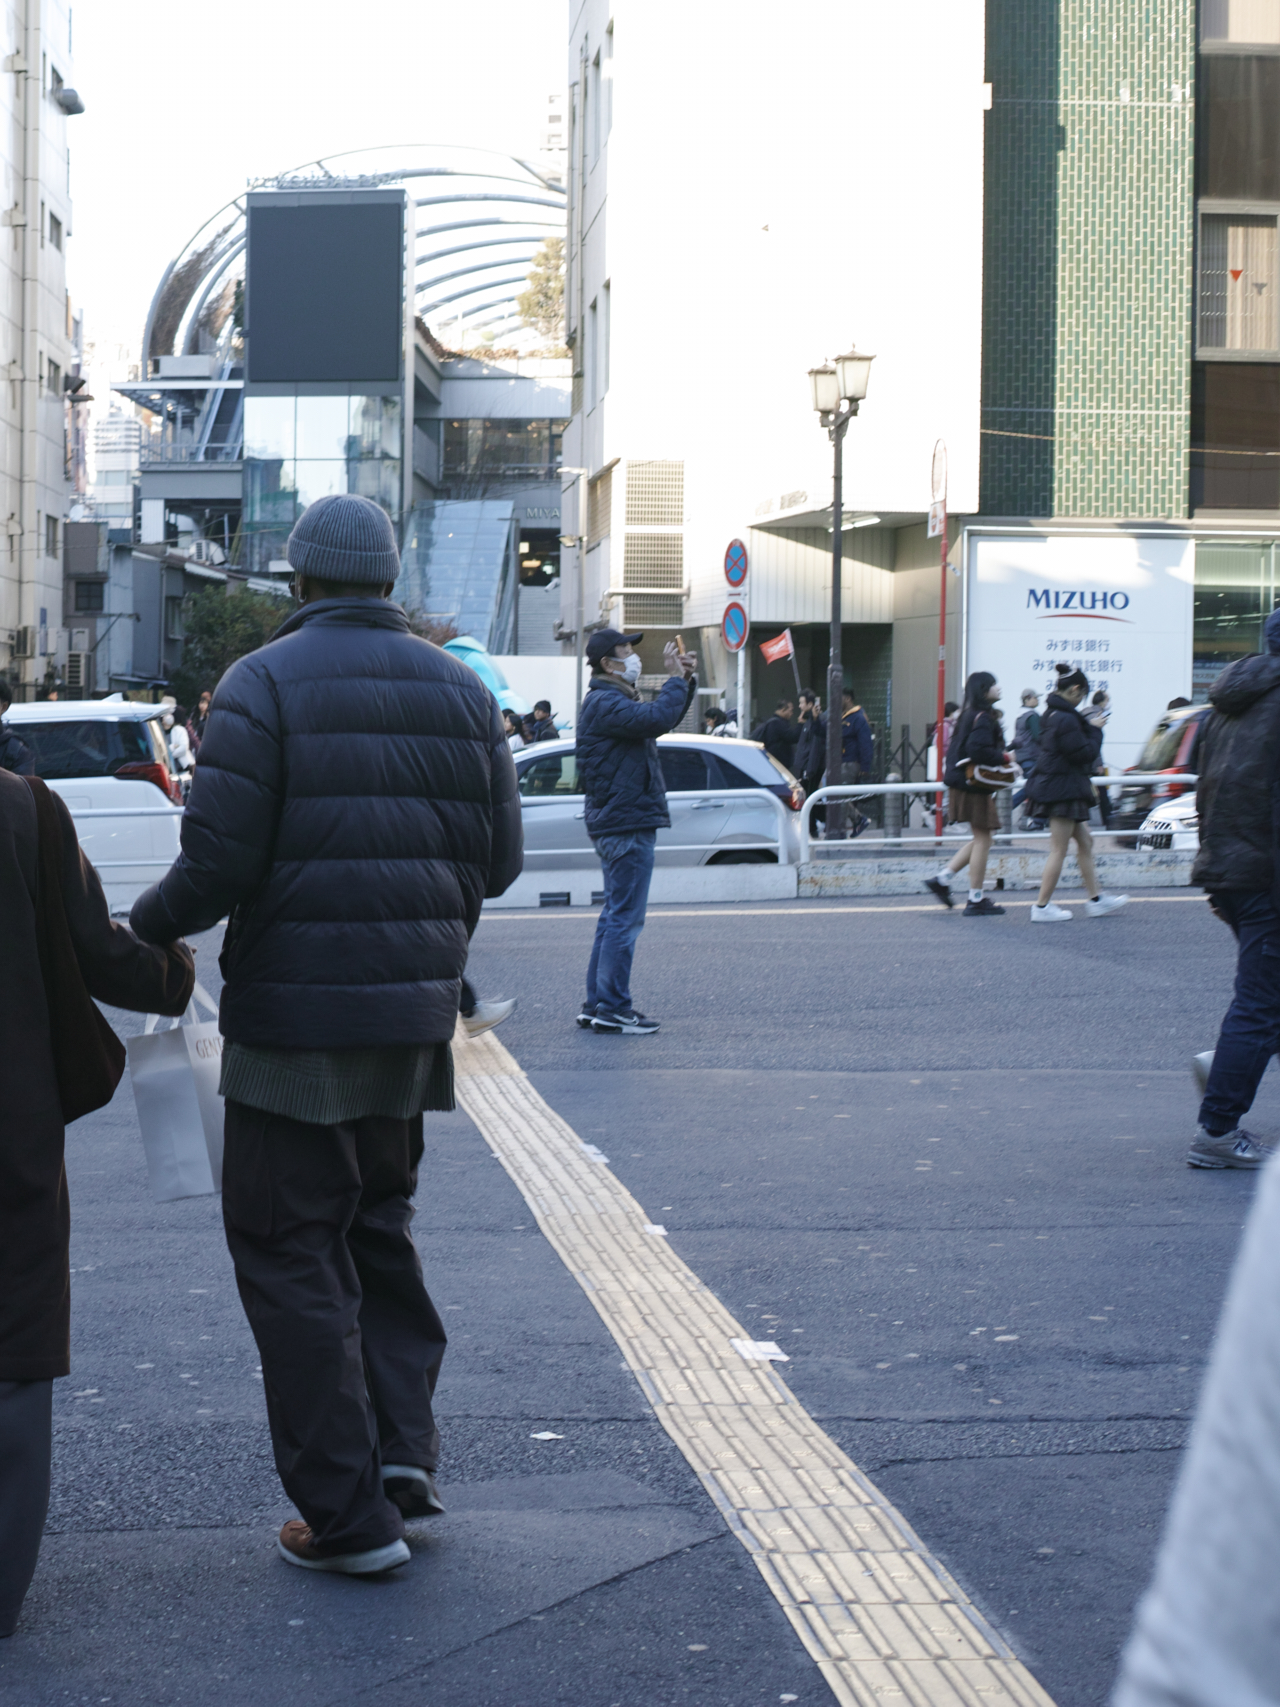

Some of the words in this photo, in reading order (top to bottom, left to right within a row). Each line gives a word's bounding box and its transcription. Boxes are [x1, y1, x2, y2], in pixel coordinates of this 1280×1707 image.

[1026, 588, 1130, 610] MIZUHO
[1046, 639, 1110, 652] みずほ銀行
[195, 1036, 225, 1059] GENT
